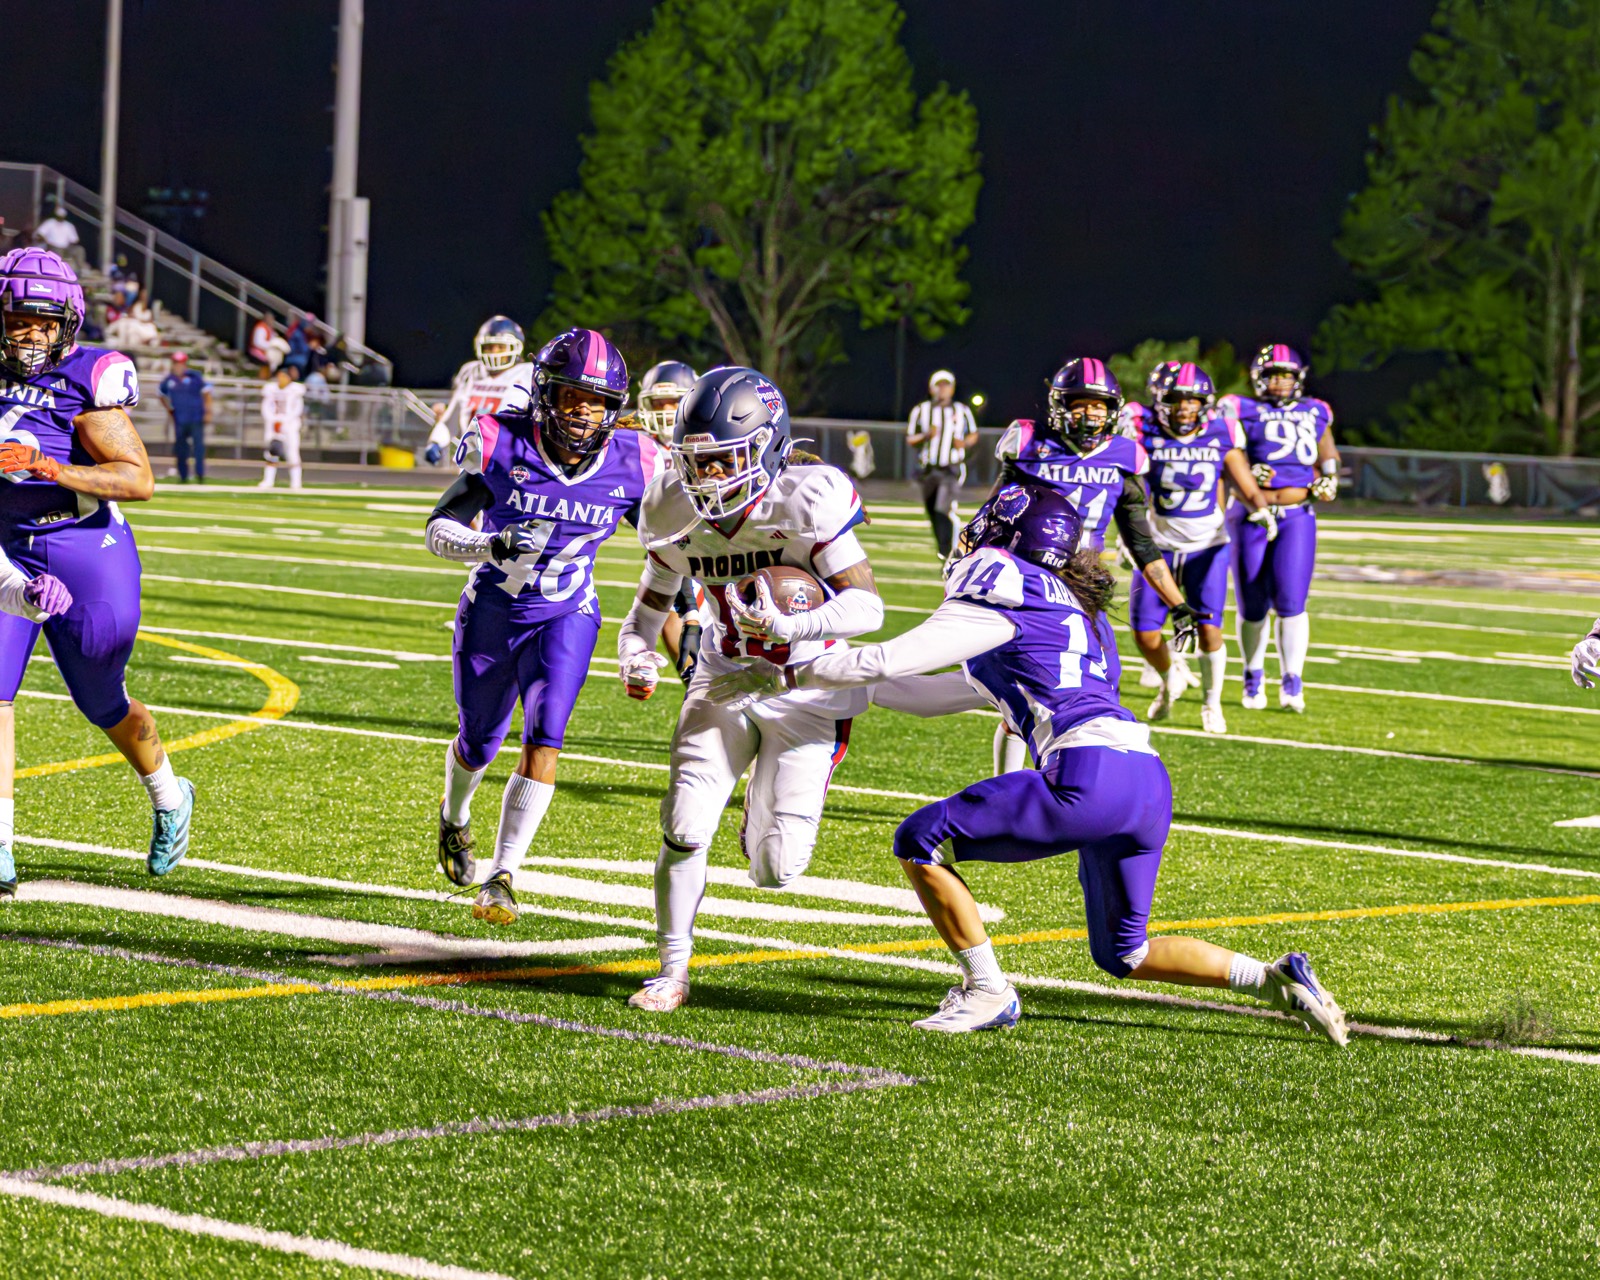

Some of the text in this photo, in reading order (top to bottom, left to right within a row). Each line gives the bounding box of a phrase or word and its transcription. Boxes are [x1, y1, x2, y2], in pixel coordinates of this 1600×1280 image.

[1152, 447, 1221, 462] ATLANTA
[1265, 420, 1318, 466] 98
[1037, 463, 1120, 484] ATLANTA
[1159, 462, 1215, 512] 52
[506, 489, 615, 524] ATLANTA
[489, 519, 609, 602] 46
[956, 558, 1006, 596] 14
[1041, 551, 1067, 568] Rid
